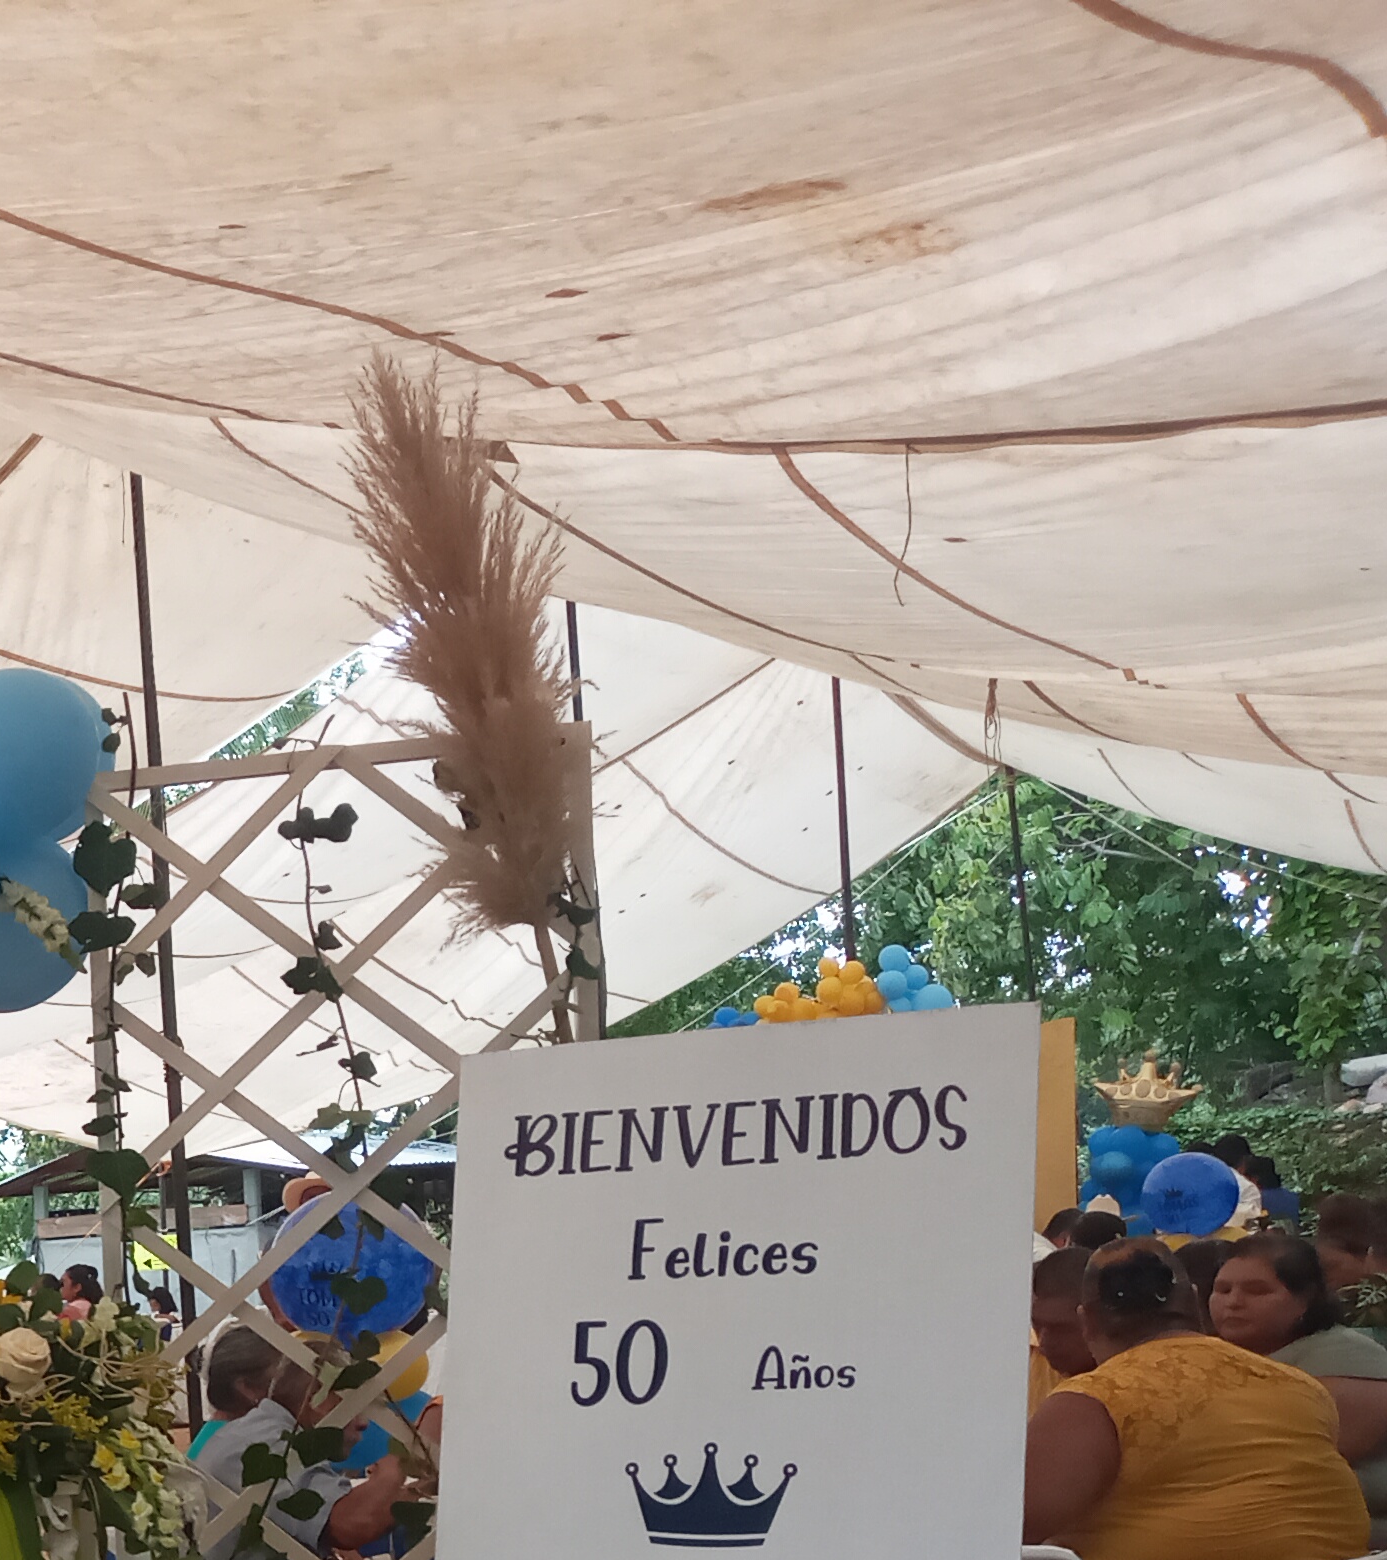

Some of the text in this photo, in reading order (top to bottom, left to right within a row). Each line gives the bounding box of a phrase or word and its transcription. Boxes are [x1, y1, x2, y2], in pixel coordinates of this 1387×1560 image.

[503, 1084, 968, 1177] BIENVENIDOS
[627, 1217, 820, 1281] Felices
[570, 1319, 858, 1407] 50 Años
